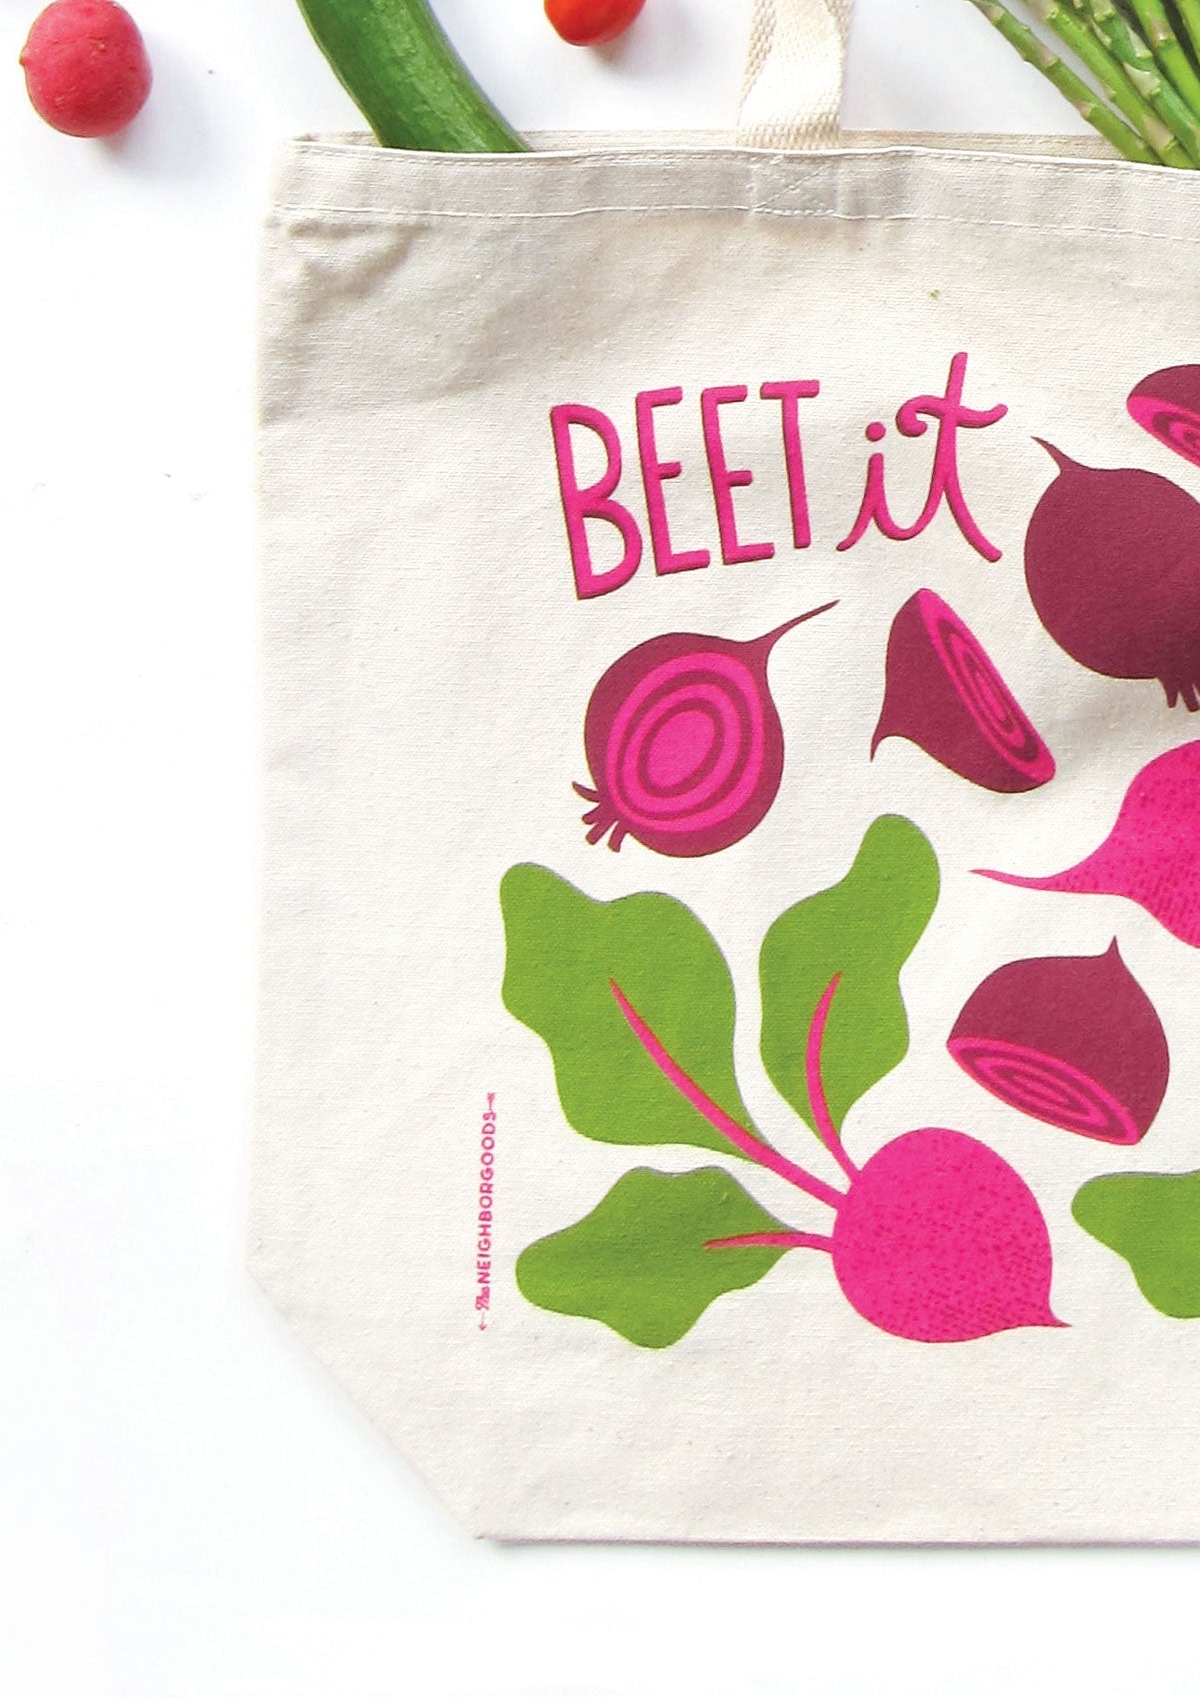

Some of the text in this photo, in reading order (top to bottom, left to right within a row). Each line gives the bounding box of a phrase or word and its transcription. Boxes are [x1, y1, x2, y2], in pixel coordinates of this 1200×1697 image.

[550, 352, 1008, 600] BEET it
[477, 1111, 496, 1284] NEIGHBORGOODS
